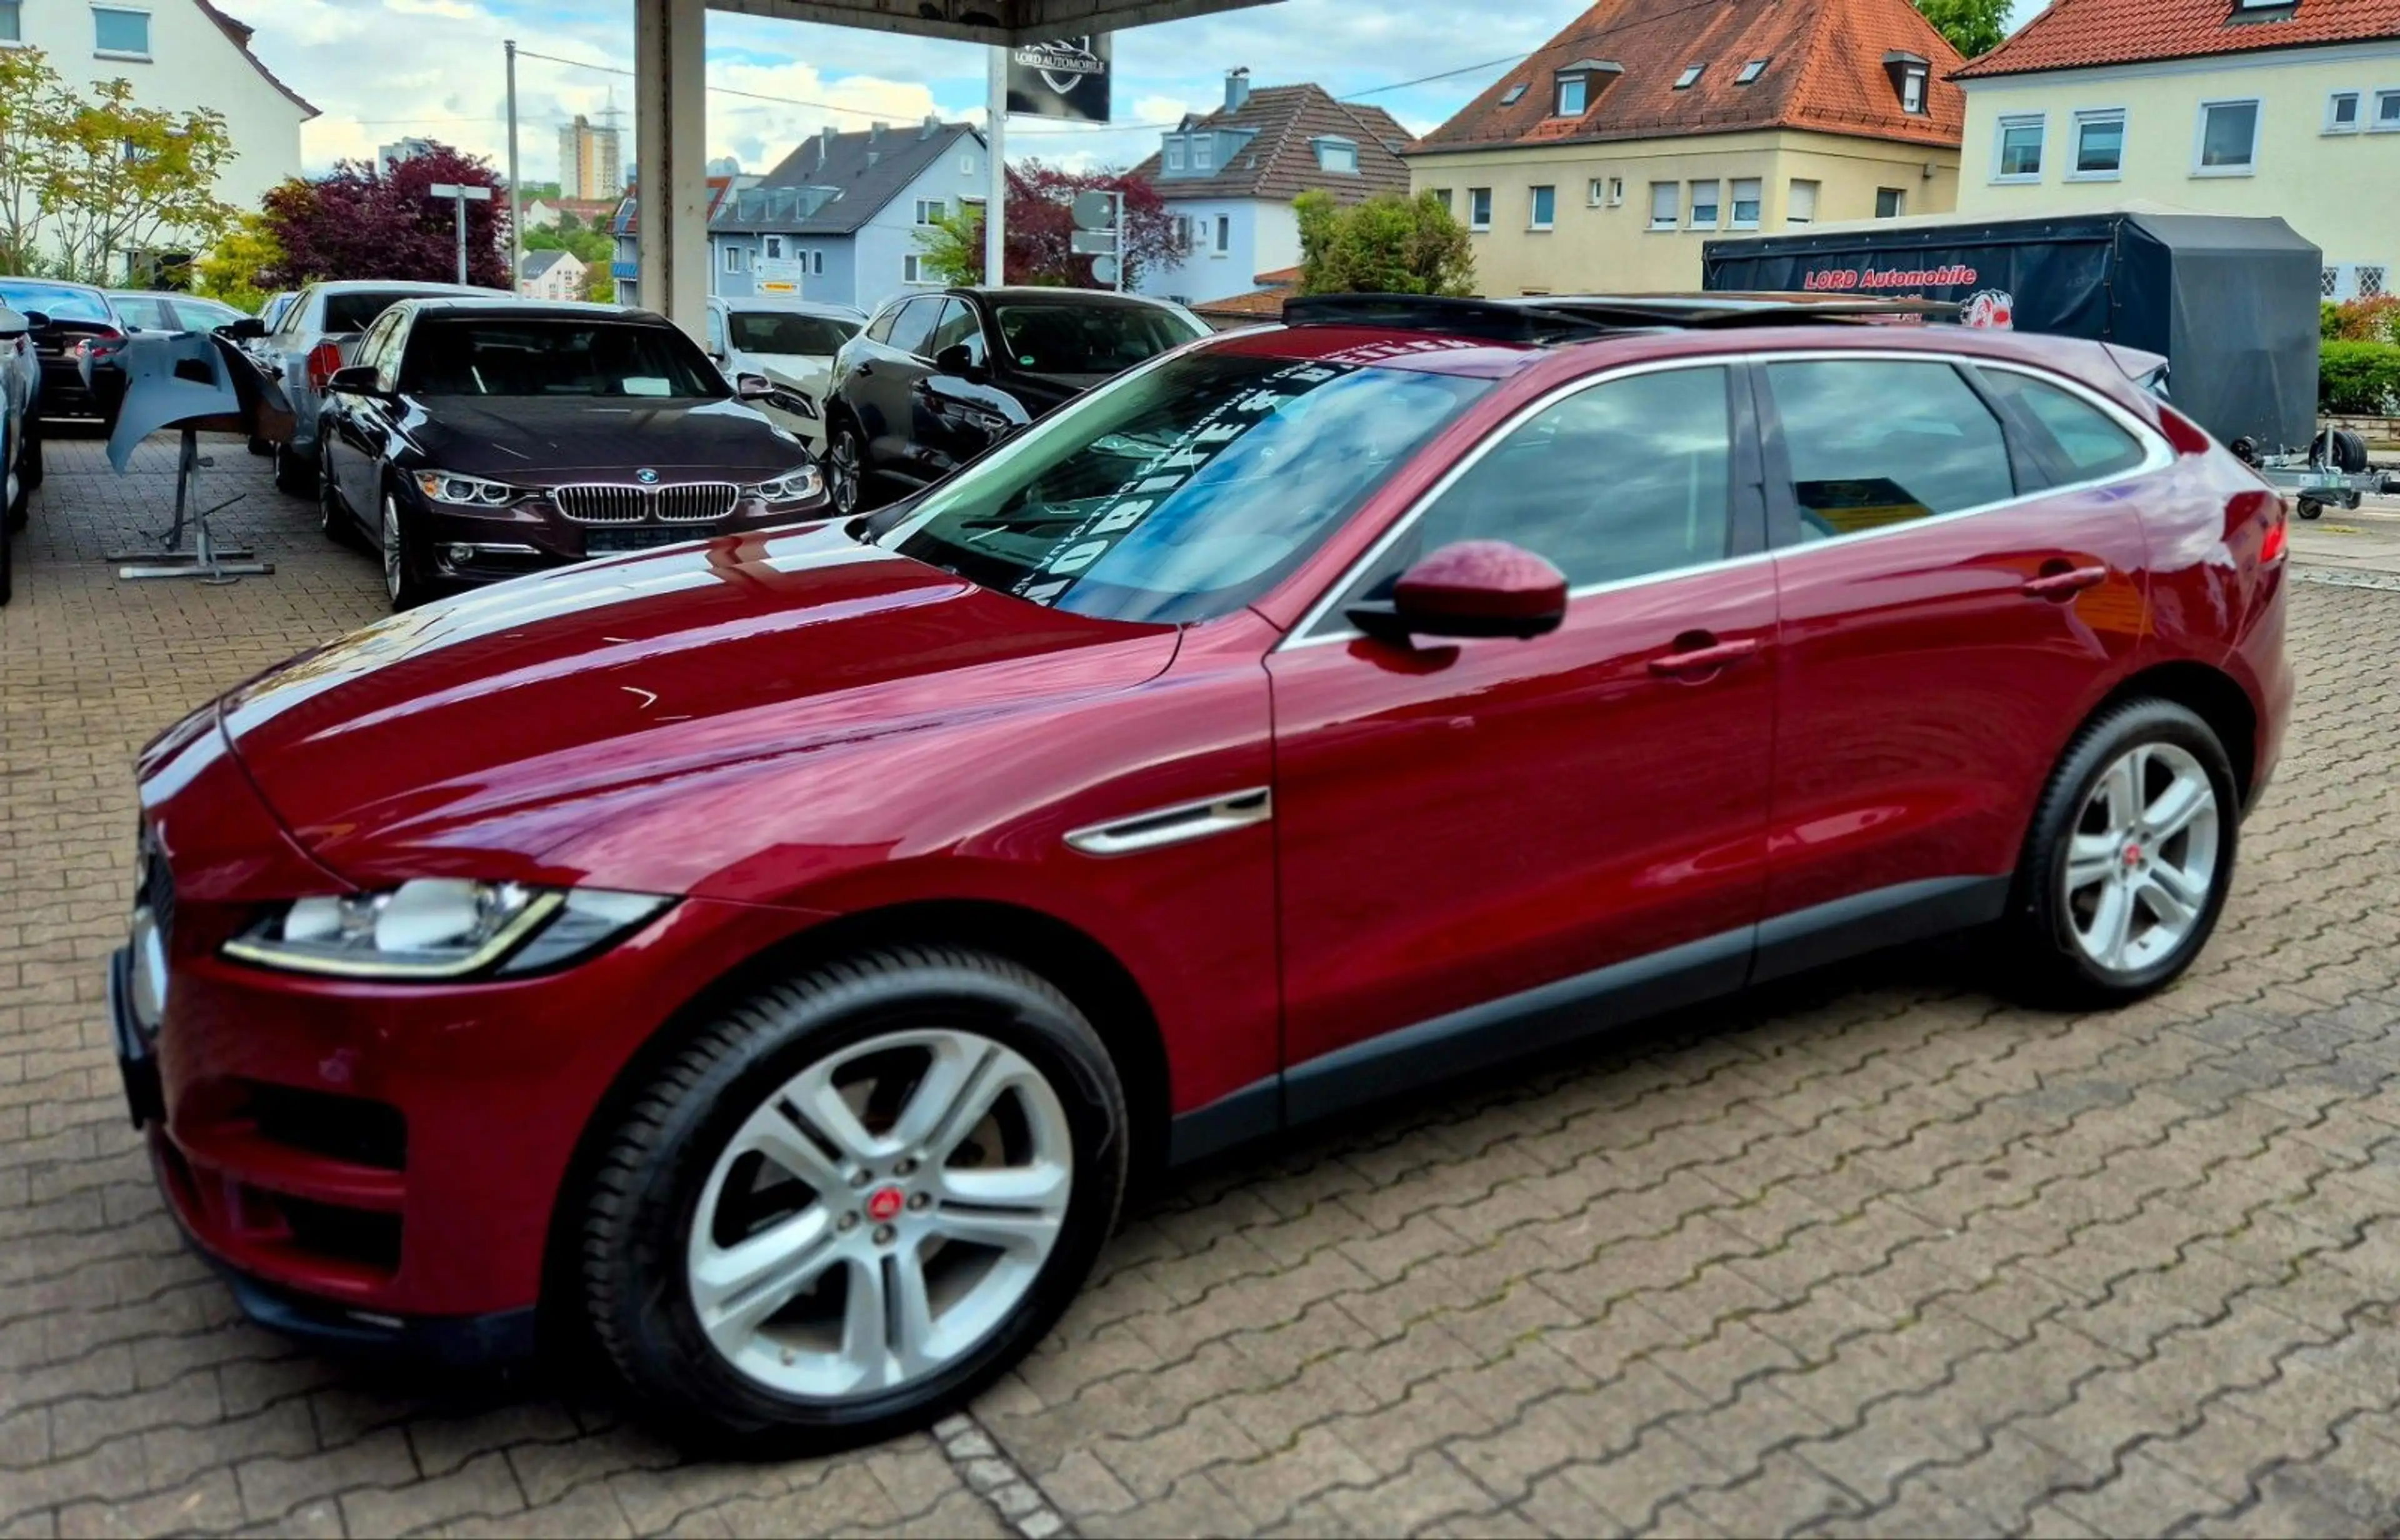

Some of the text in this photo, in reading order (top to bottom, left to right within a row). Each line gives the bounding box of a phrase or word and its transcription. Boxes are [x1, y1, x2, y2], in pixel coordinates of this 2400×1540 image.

[1016, 52, 1104, 73] LORD AUTOMOBILE
[1804, 265, 1977, 289] LORD Automobile
